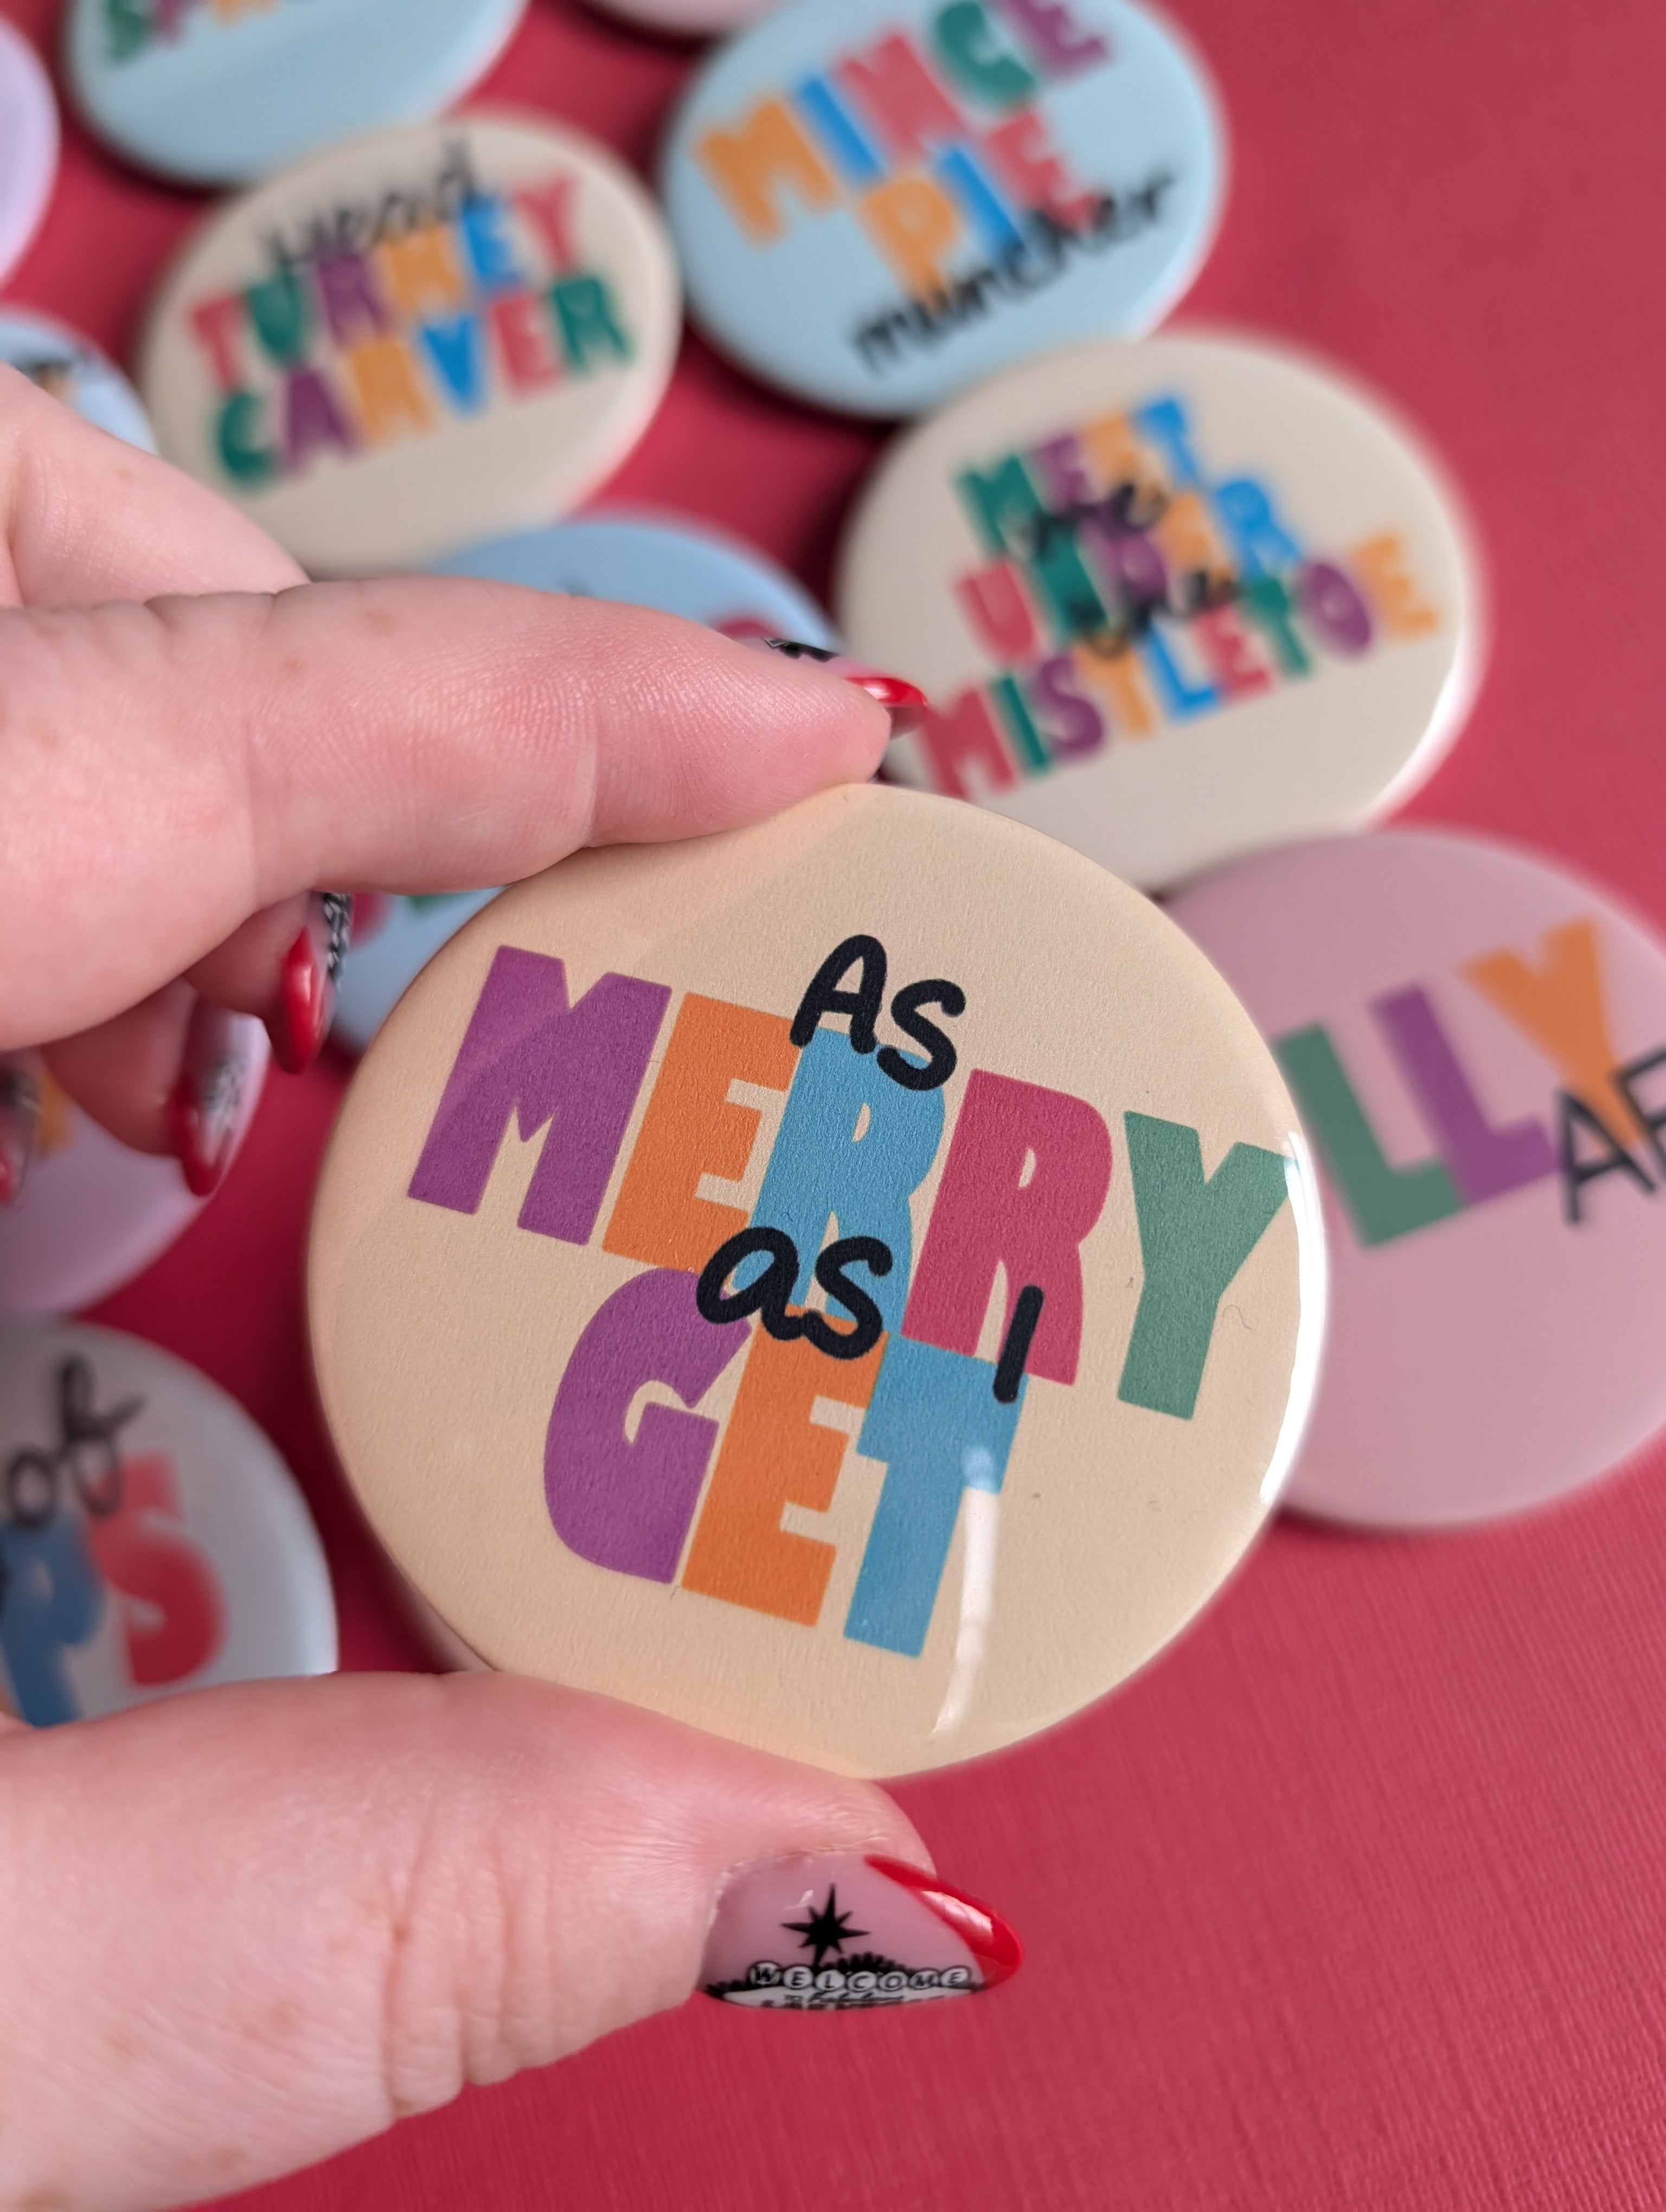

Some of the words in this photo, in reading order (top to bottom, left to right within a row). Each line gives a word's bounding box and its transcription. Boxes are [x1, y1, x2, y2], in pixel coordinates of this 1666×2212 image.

[694, 0, 1113, 249] MINCE
[858, 107, 1103, 313] PIE
[193, 172, 580, 390] TURKEY
[216, 274, 635, 491] CARVER
[917, 530, 1443, 799] MISTLETOE
[790, 934, 966, 1090] AS
[407, 944, 1302, 1420] MERRY
[696, 1226, 893, 1359] as
[994, 1285, 1043, 1404] I
[543, 1268, 1028, 1658] GET
[751, 1962, 970, 1991] WELCOME
